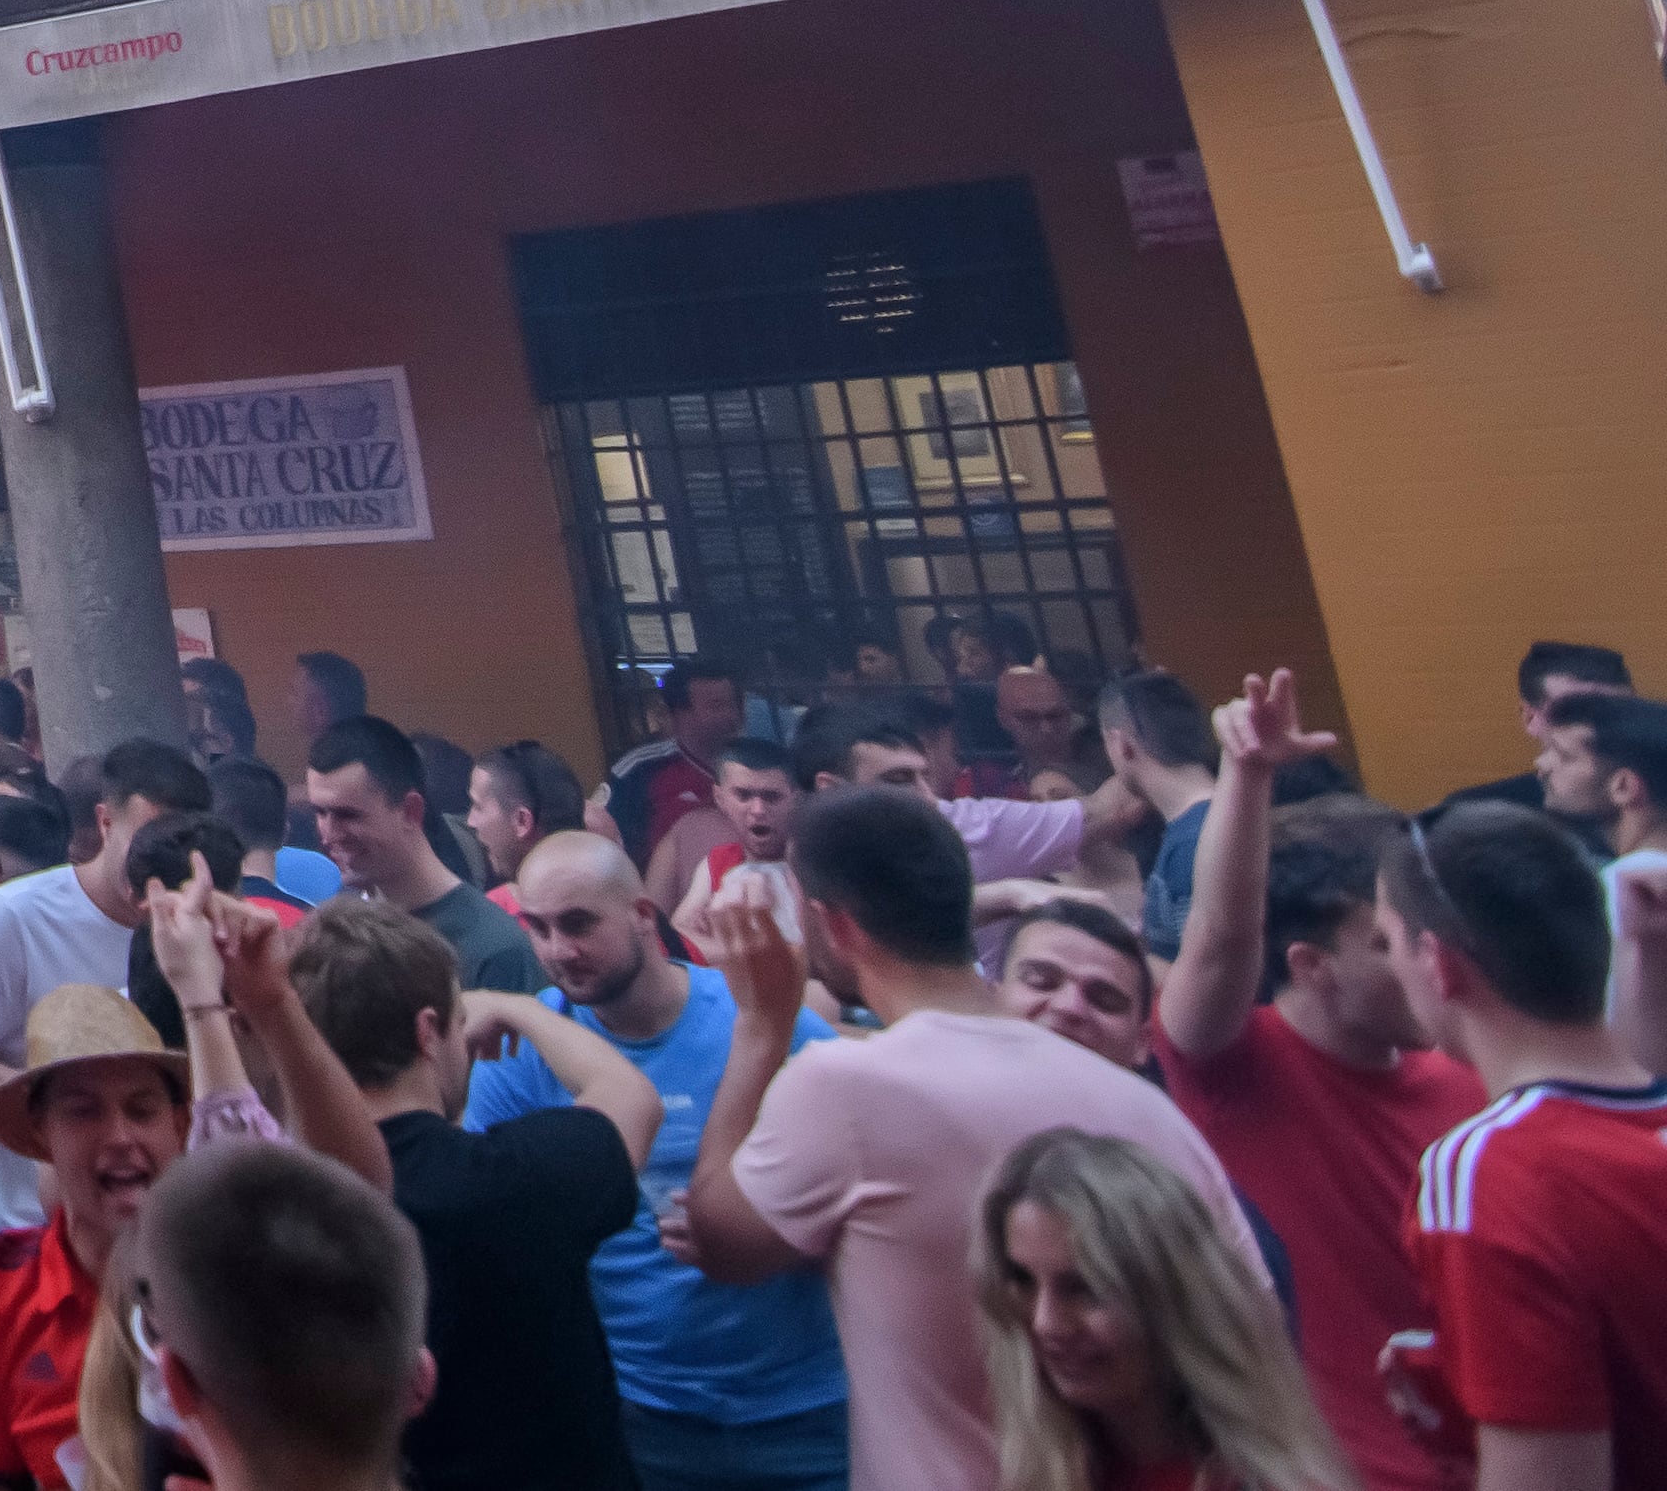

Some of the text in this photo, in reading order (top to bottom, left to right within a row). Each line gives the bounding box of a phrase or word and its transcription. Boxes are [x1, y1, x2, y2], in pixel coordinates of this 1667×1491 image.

[25, 31, 183, 77] Cruzcampo
[141, 395, 319, 451] BODEGA
[151, 442, 405, 502] SANTA CRUZ
[173, 497, 383, 534] LAS COLUMNAS
